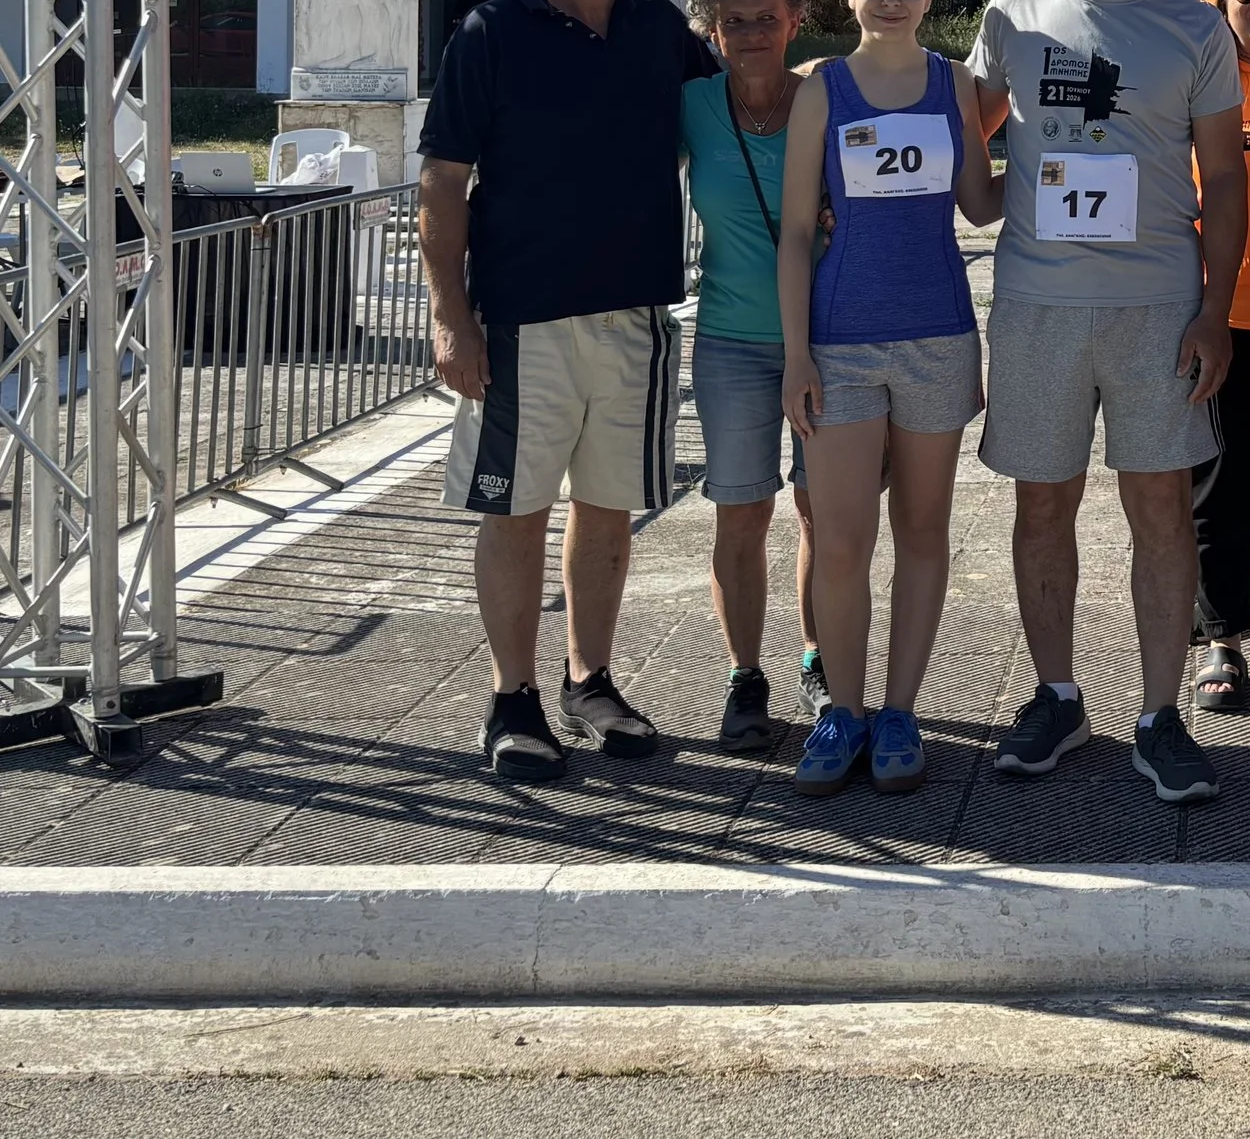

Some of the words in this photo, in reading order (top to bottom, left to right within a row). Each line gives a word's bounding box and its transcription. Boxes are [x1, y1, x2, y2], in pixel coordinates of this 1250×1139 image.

[1051, 59, 1089, 69] ΔΡΟΜΟΣ
[1050, 68, 1088, 78] ΜΝΗΜΗΣ
[1047, 85, 1064, 100] 21
[875, 145, 922, 176] 20
[1063, 190, 1107, 218] 17
[478, 474, 510, 488] FROXY
